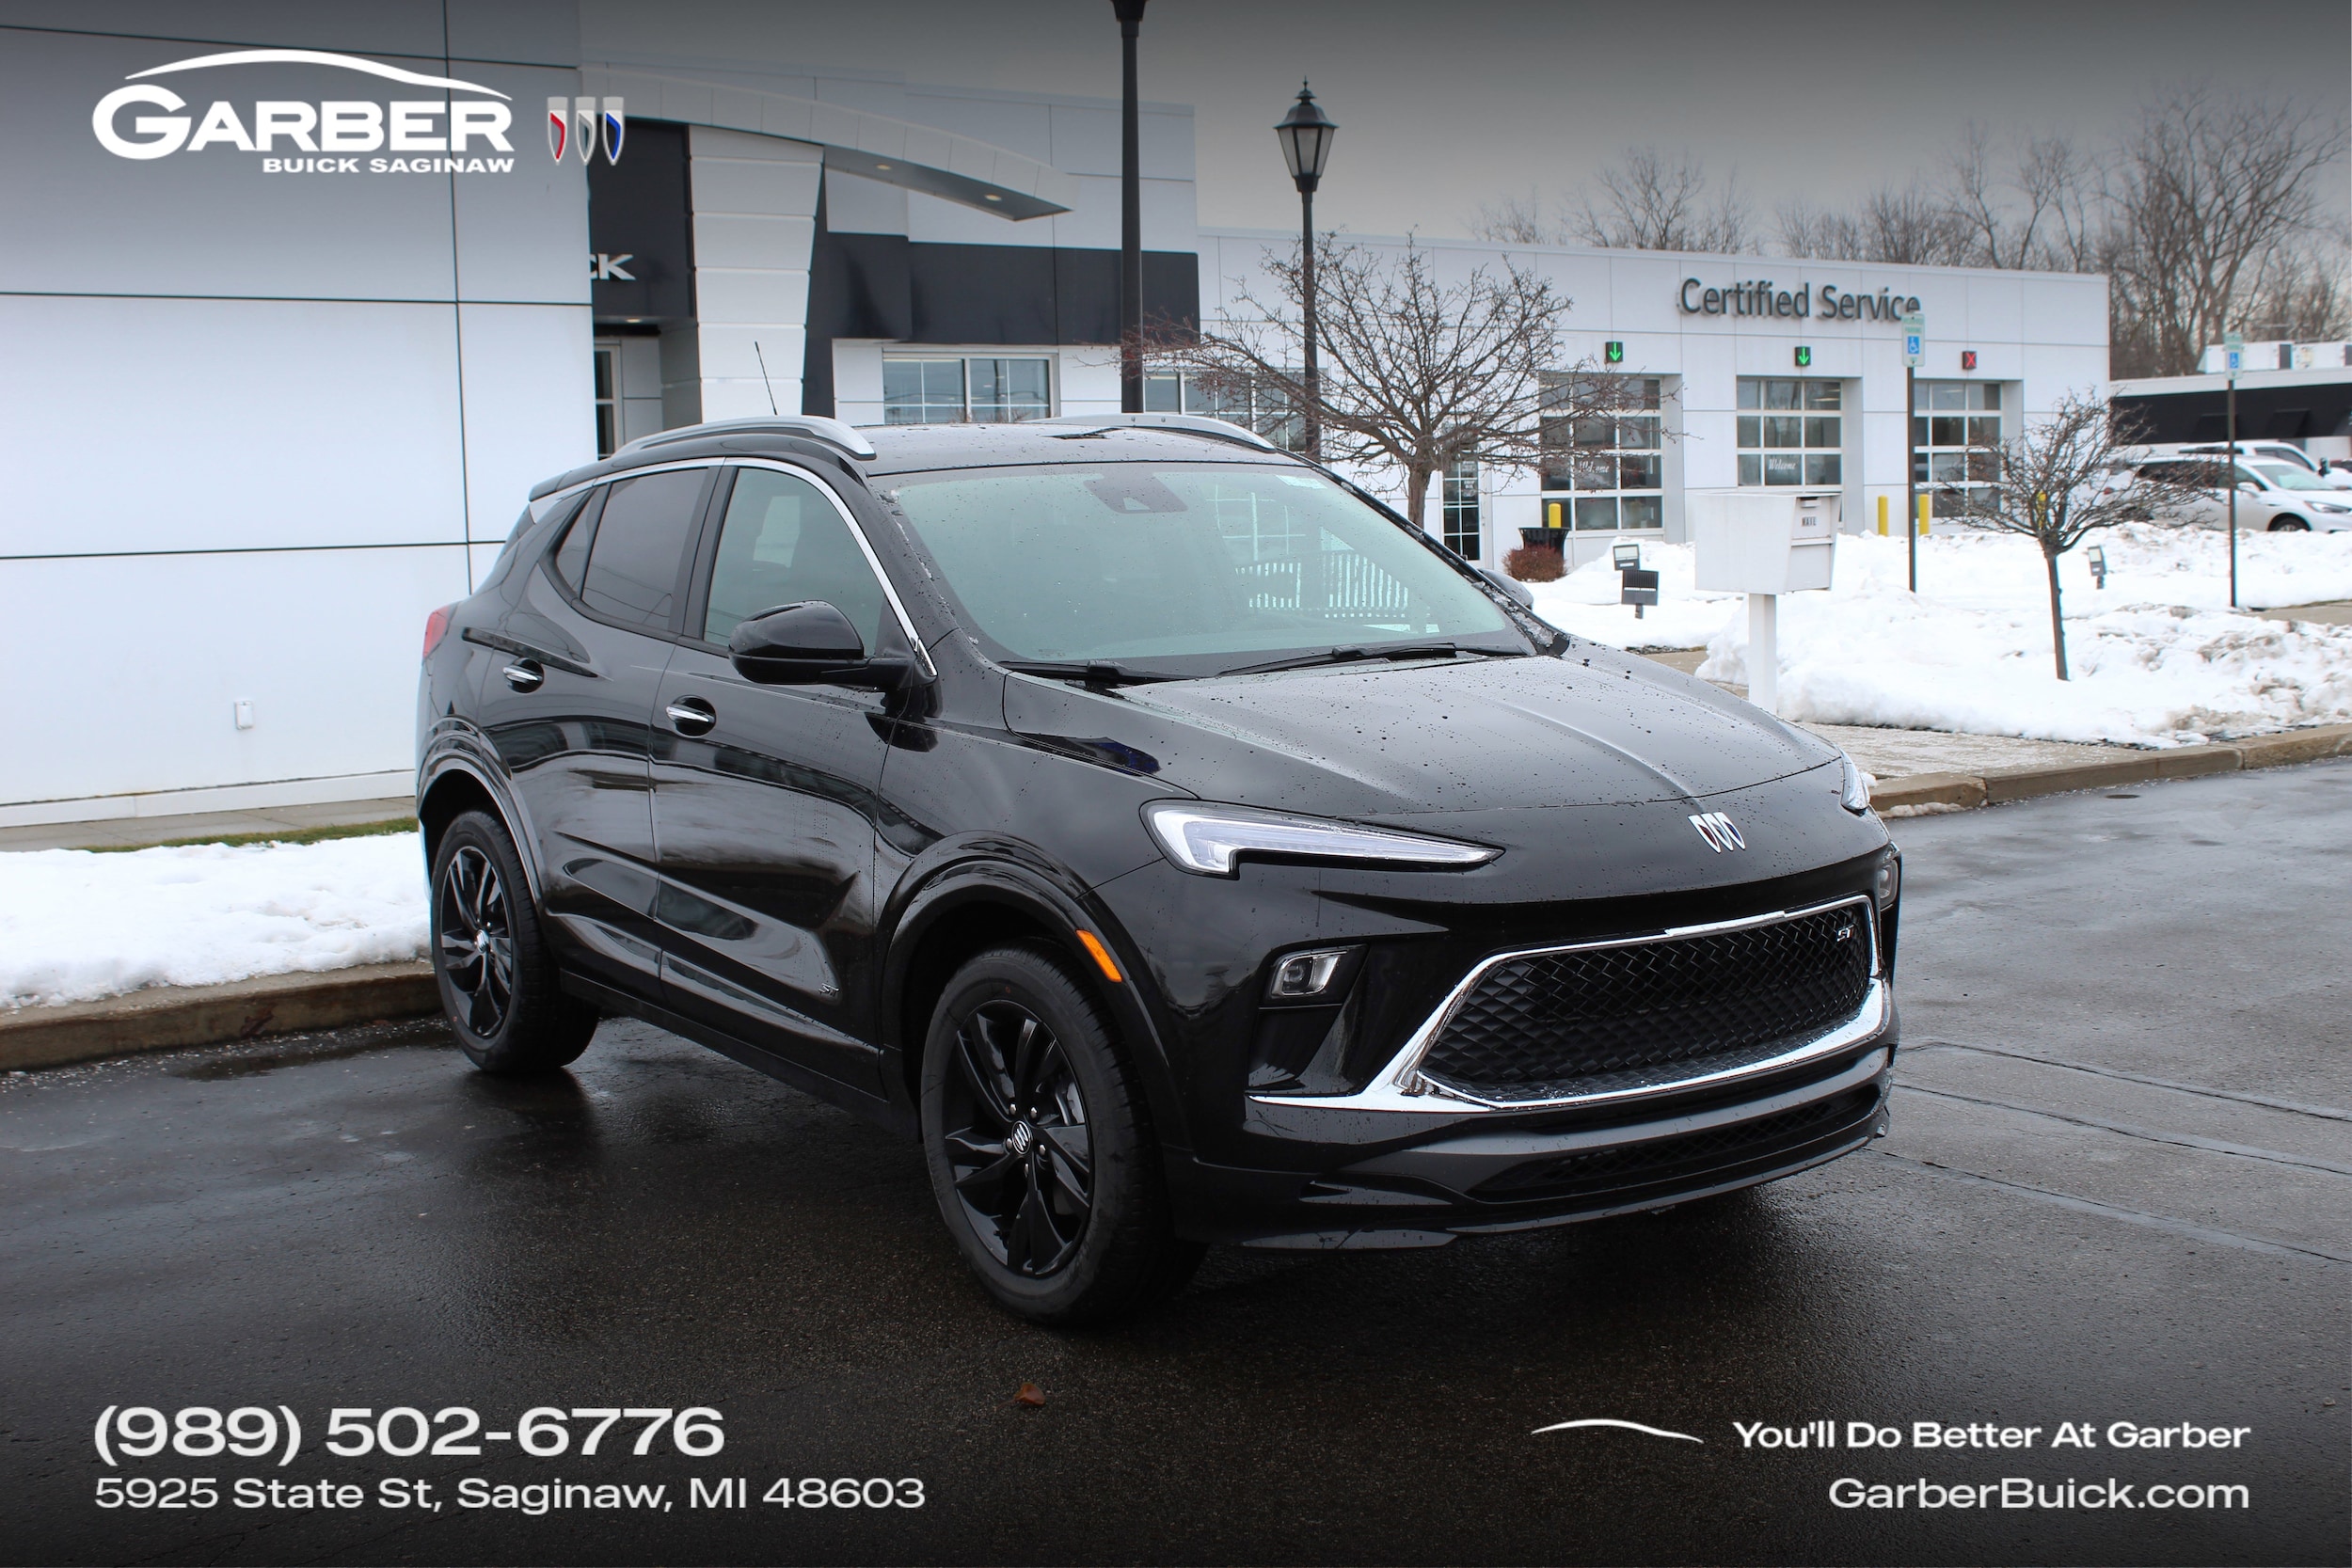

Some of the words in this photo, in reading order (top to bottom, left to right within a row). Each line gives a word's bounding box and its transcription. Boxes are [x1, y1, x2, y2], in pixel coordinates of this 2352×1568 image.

[1680, 277, 1810, 317] Certified
[1820, 285, 1921, 321] Service
[1769, 458, 1797, 470] Welcome
